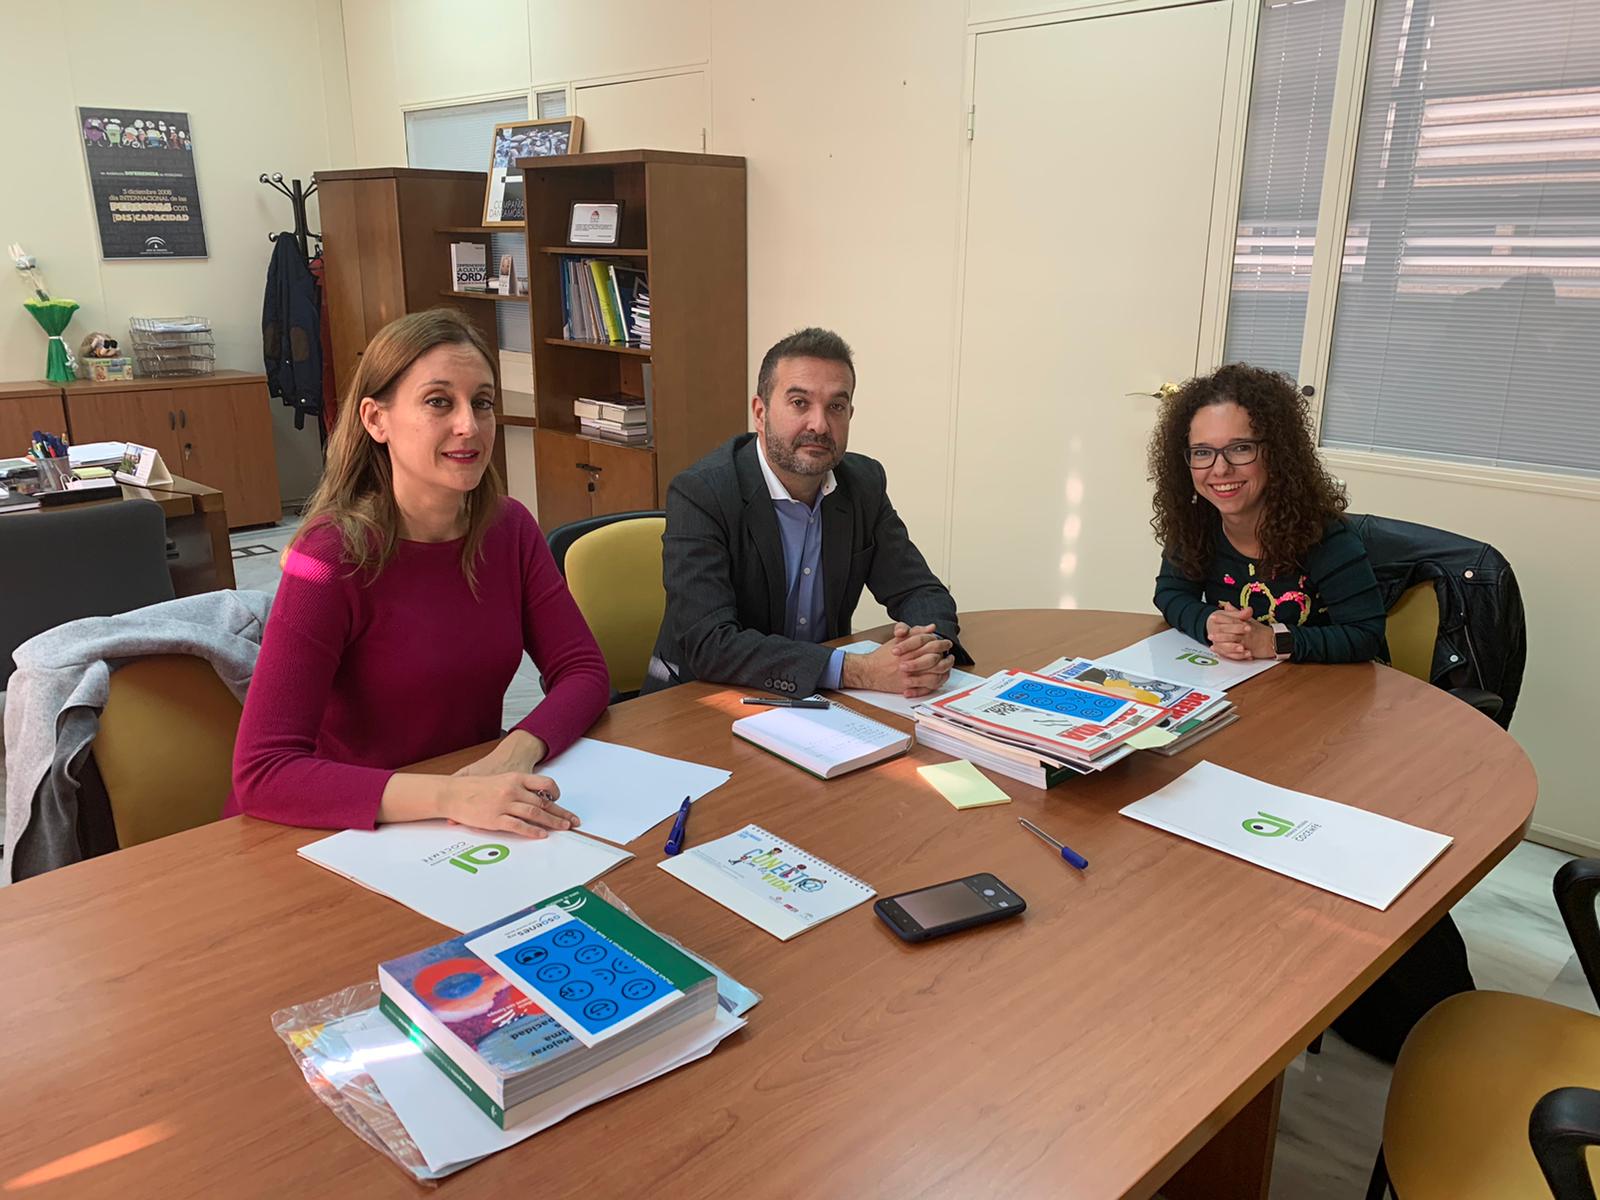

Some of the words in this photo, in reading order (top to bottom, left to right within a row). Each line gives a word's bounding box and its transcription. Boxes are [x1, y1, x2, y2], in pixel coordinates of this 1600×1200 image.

[457, 272, 487, 282] SORDA
[510, 1017, 556, 1040] pacidad
[530, 1035, 575, 1057] Mejorar
